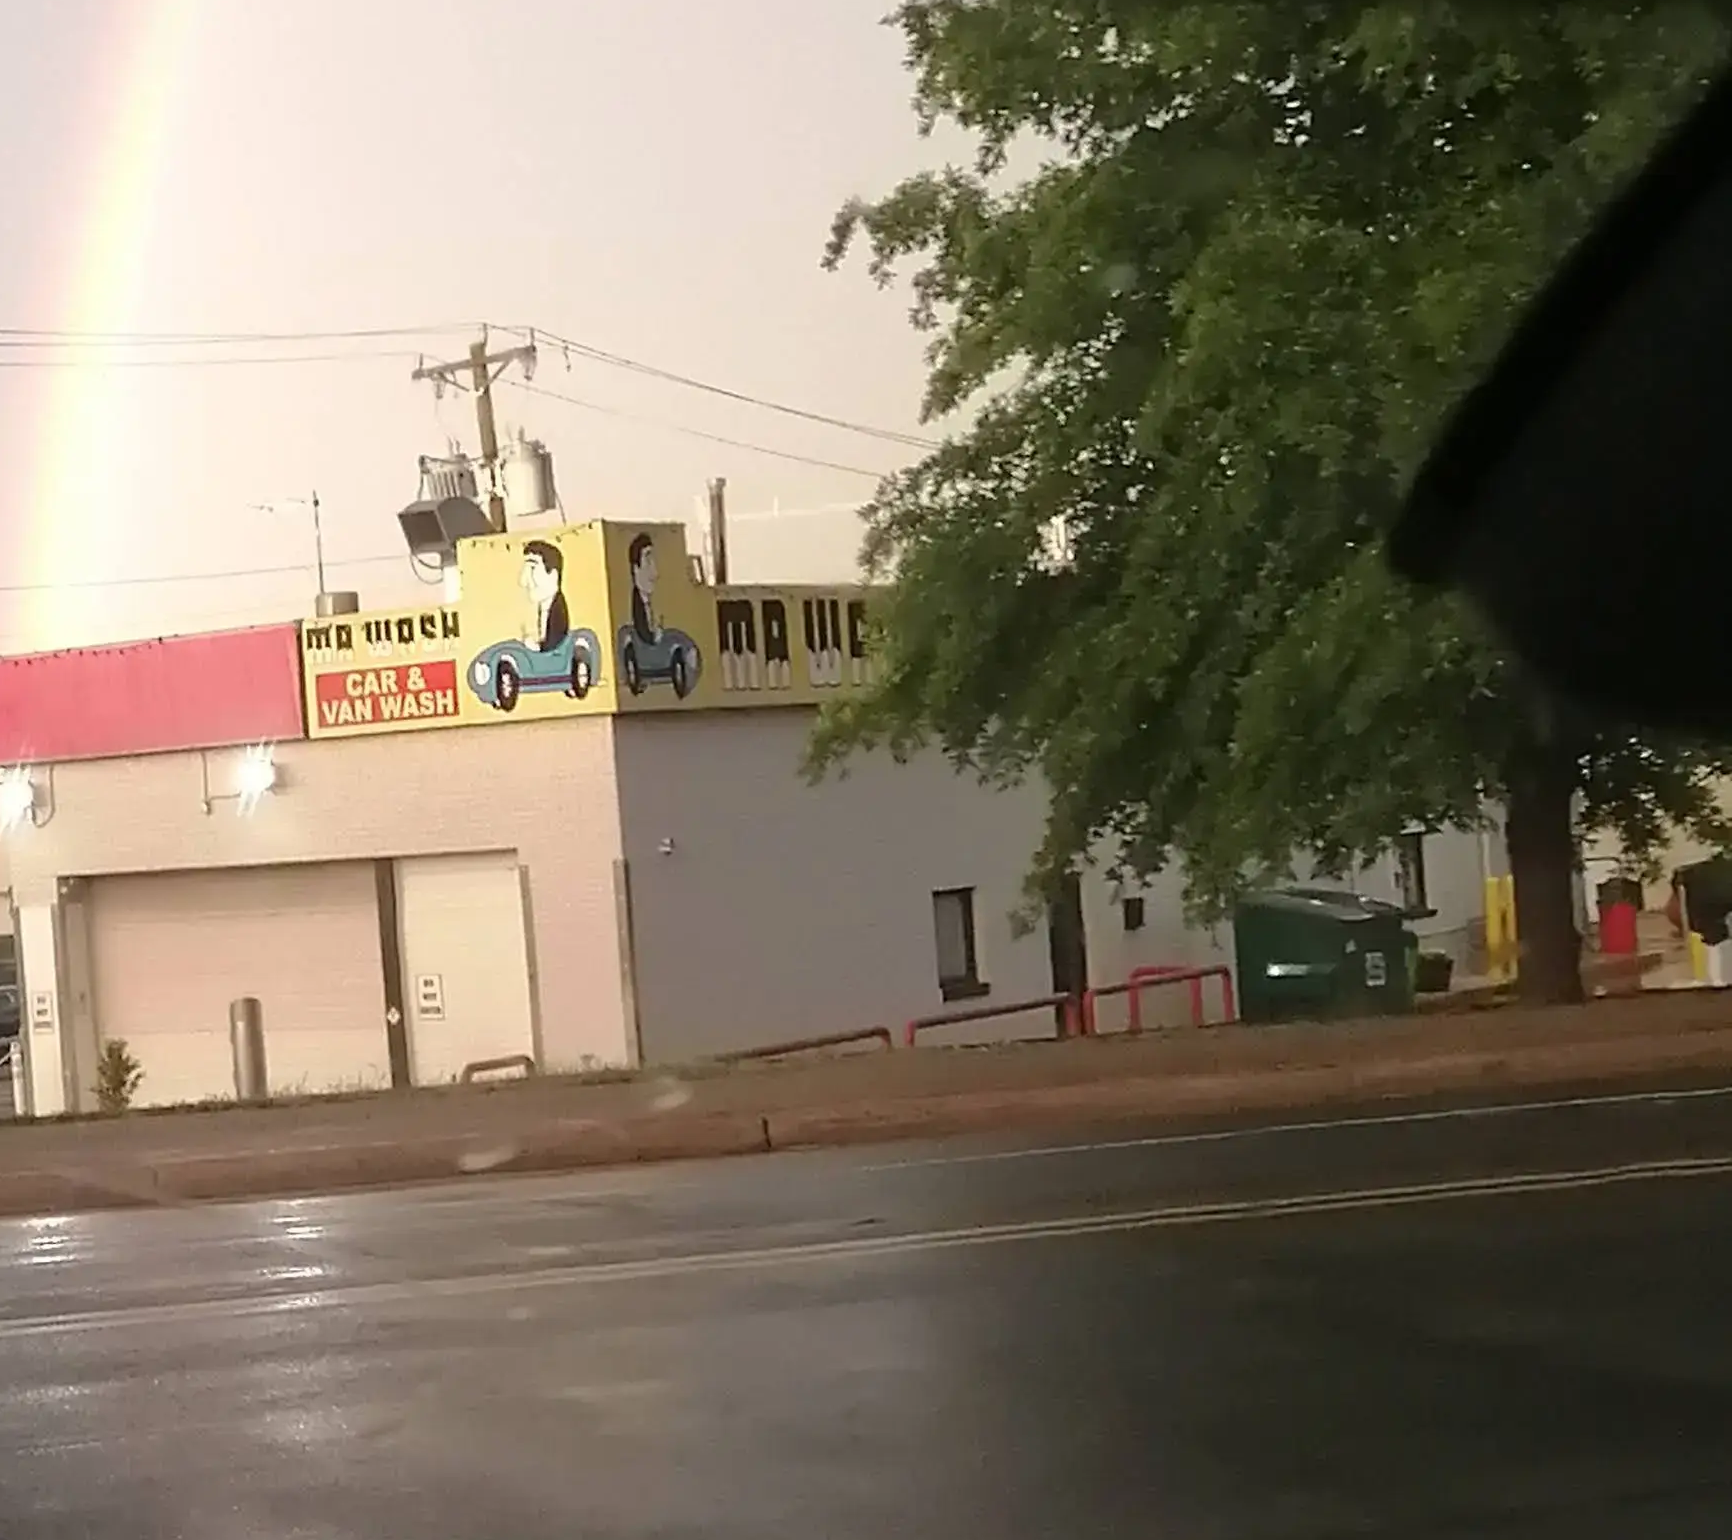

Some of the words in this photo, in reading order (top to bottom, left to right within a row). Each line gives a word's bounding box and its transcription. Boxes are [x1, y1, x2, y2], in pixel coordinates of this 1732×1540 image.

[364, 611, 460, 656] WASH
[345, 669, 399, 698] CAR
[406, 666, 426, 692] &
[321, 697, 373, 725] VAN
[379, 688, 455, 720] WASH
